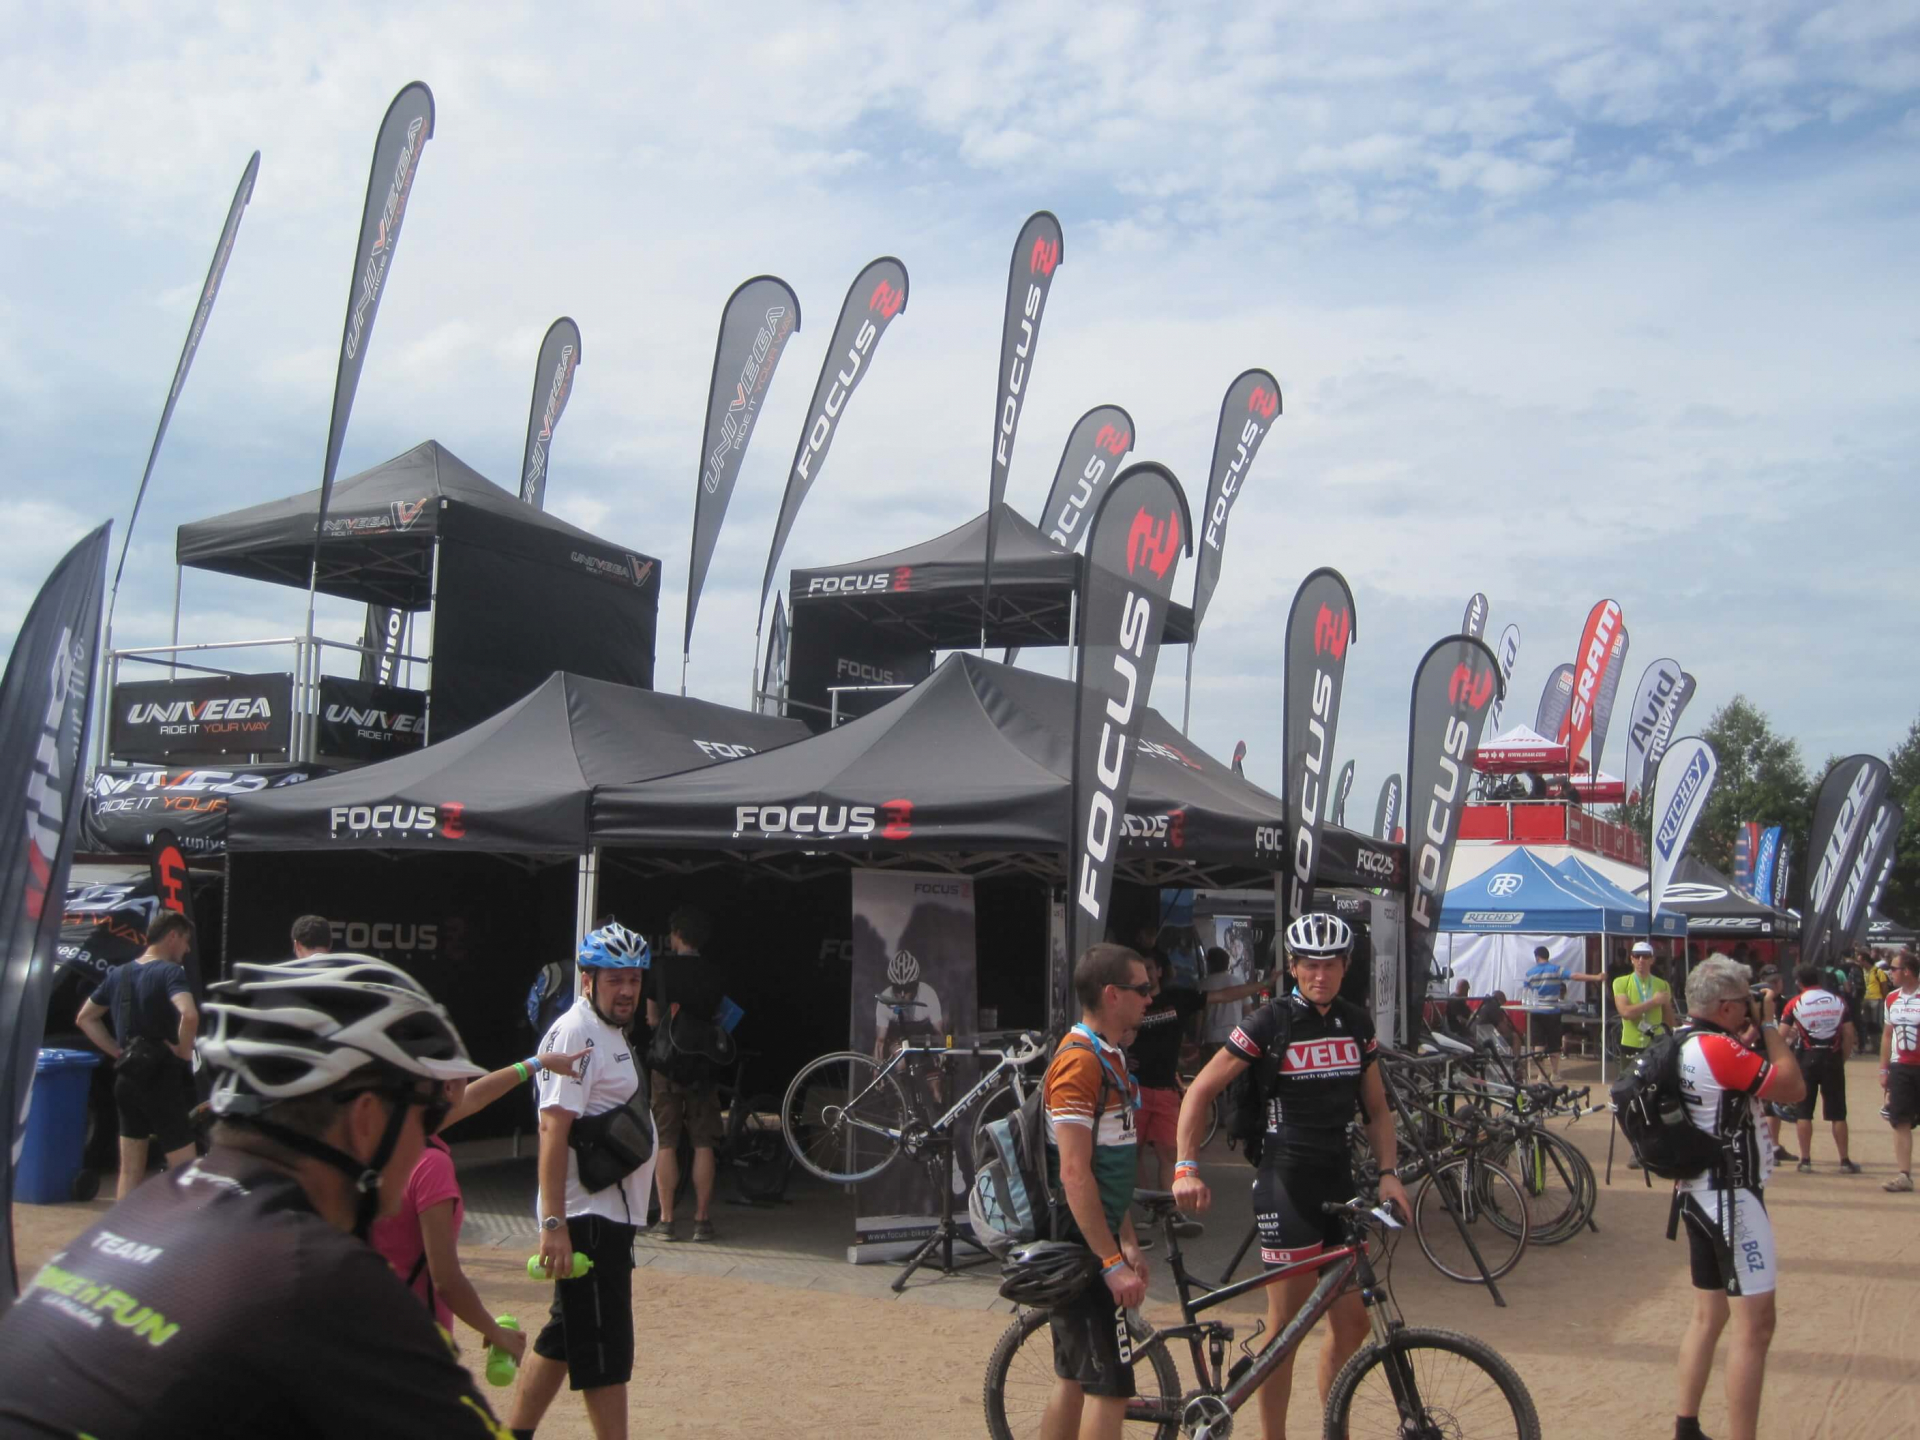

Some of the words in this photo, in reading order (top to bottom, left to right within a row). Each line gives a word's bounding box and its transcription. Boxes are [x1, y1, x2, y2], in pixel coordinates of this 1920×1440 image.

[995, 284, 1042, 467] FOCUS
[704, 306, 785, 493] UNIVEGA
[797, 319, 877, 480] FOCUS
[1204, 418, 1258, 550] FOCUS
[808, 573, 890, 593] FOCUS
[837, 658, 894, 686] FOCUS
[128, 697, 272, 724] UNIVEGA
[160, 724, 188, 735] RIDE
[189, 724, 200, 735] IT
[203, 722, 239, 734] YOUR
[240, 721, 271, 733] WAY
[1630, 668, 1676, 755] Avid
[357, 729, 380, 741] RIDE
[381, 731, 392, 742] IT
[1078, 591, 1151, 920] FOCUS
[1289, 668, 1333, 919] FOCUS
[1657, 756, 1703, 851] RITCHEY
[330, 804, 436, 831] FOCUS
[735, 805, 876, 833] FOCUS
[1411, 715, 1470, 928] FOCUS
[1809, 762, 1879, 914] ZIPP
[1356, 848, 1395, 876] FOCUS
[913, 882, 960, 896] FOCUS
[1465, 912, 1521, 924] RITCHEY
[1687, 917, 1763, 929] ZIPP
[1285, 1041, 1362, 1070] VELO
[942, 1070, 1002, 1129] FOCUS
[90, 1230, 165, 1265] TEAM
[1741, 1239, 1766, 1274] BGZ
[1114, 1305, 1130, 1365] VELO
